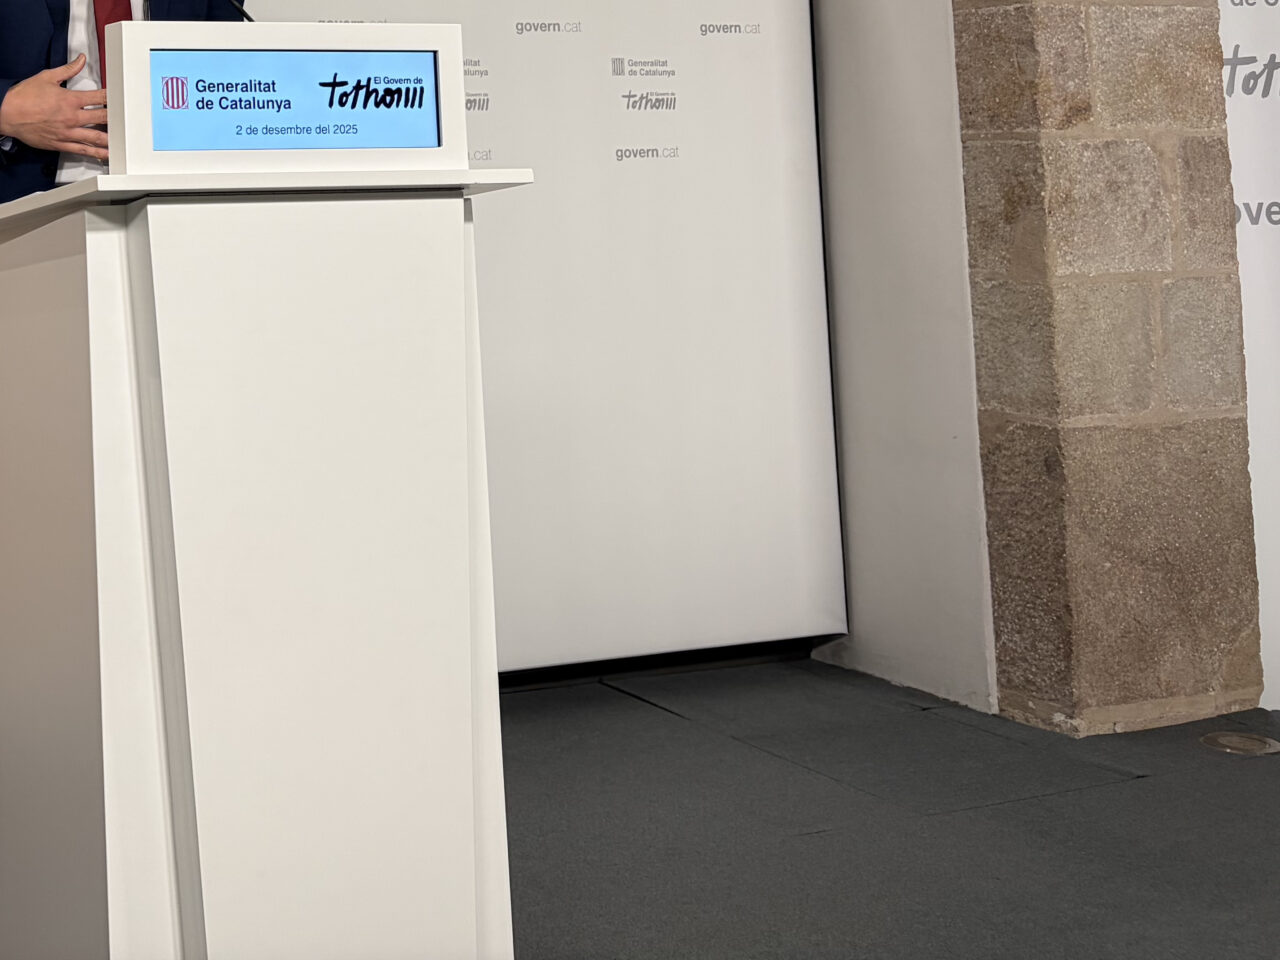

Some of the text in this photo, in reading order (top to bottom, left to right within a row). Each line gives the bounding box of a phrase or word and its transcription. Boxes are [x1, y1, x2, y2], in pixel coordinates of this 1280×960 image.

[515, 20, 582, 35] govern.cat
[700, 23, 760, 36] govern.cat
[464, 59, 480, 67] litat
[628, 59, 668, 67] Generalitat
[464, 68, 488, 78] alunya
[628, 68, 675, 78] de Catalunya
[195, 79, 277, 93] Generalitat
[374, 76, 423, 85] El Govern de
[195, 96, 292, 113] de Catalunya
[235, 124, 359, 136] 2 de desembre del 2025
[615, 146, 680, 161] govern.cat
